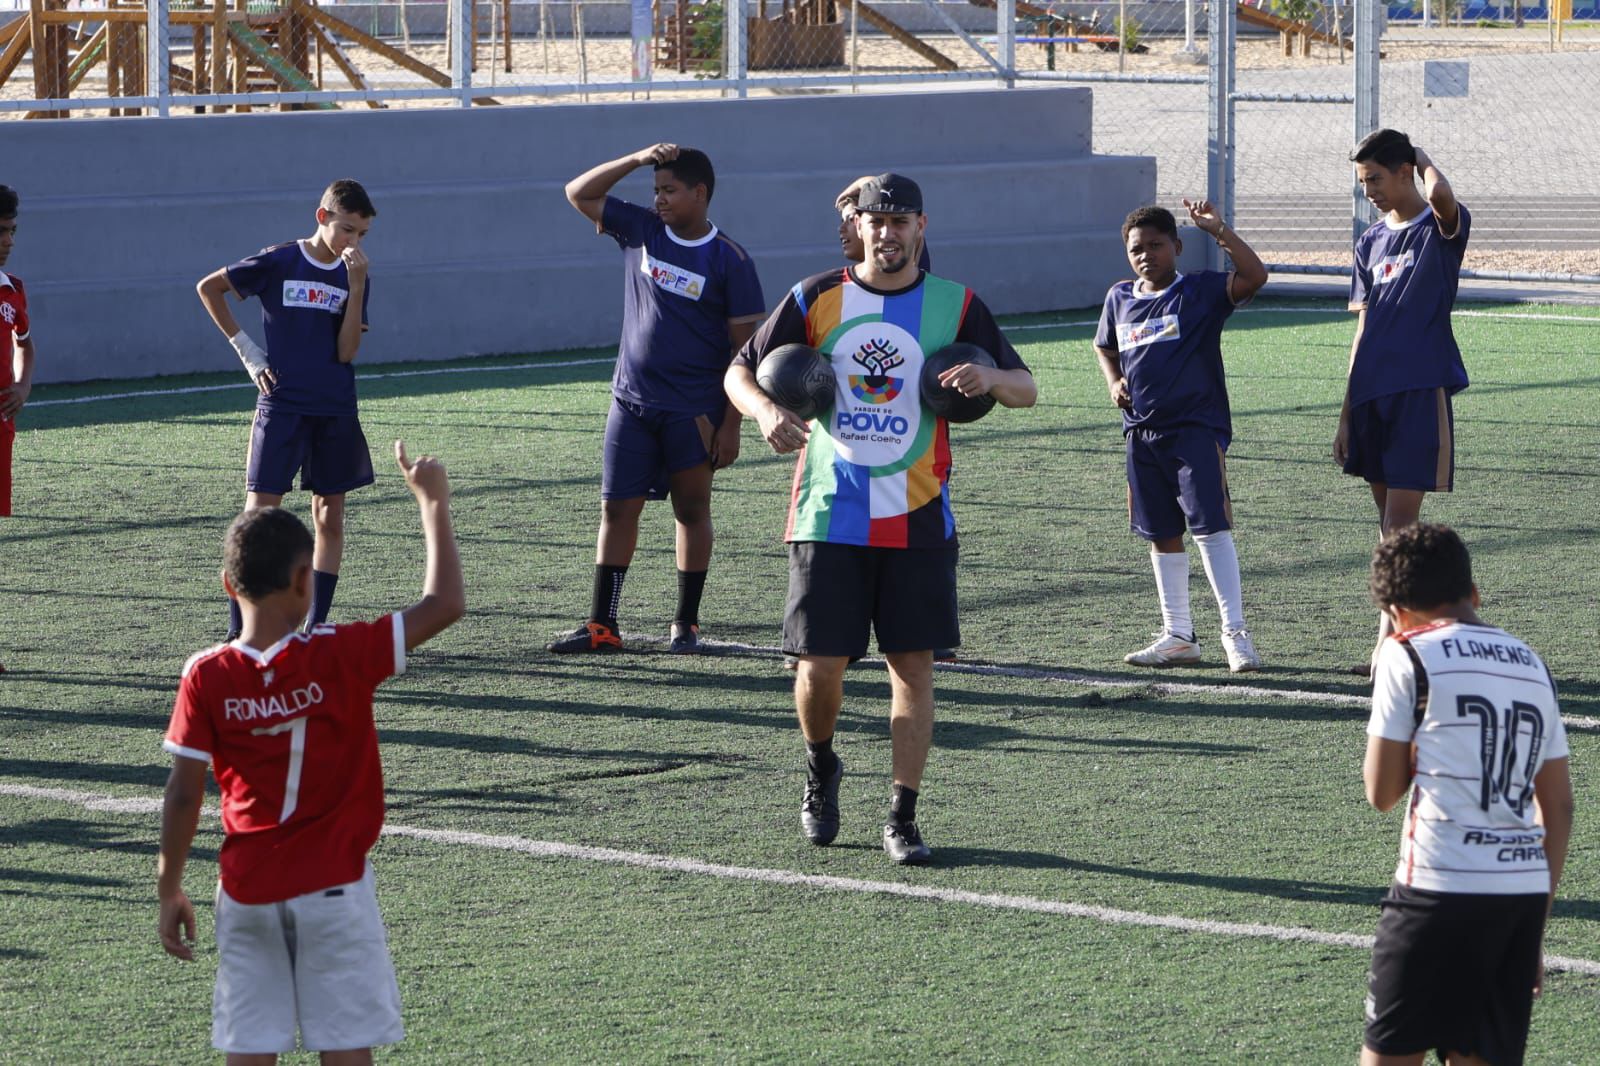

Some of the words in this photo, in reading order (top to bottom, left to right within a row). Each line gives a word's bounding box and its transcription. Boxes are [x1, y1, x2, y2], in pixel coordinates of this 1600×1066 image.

[285, 287, 341, 307] CAMPE
[837, 412, 909, 436] POVO
[840, 432, 868, 441] Rafael
[870, 434, 902, 445] Coelho
[224, 682, 324, 721] RONALDO
[251, 716, 308, 824] 7
